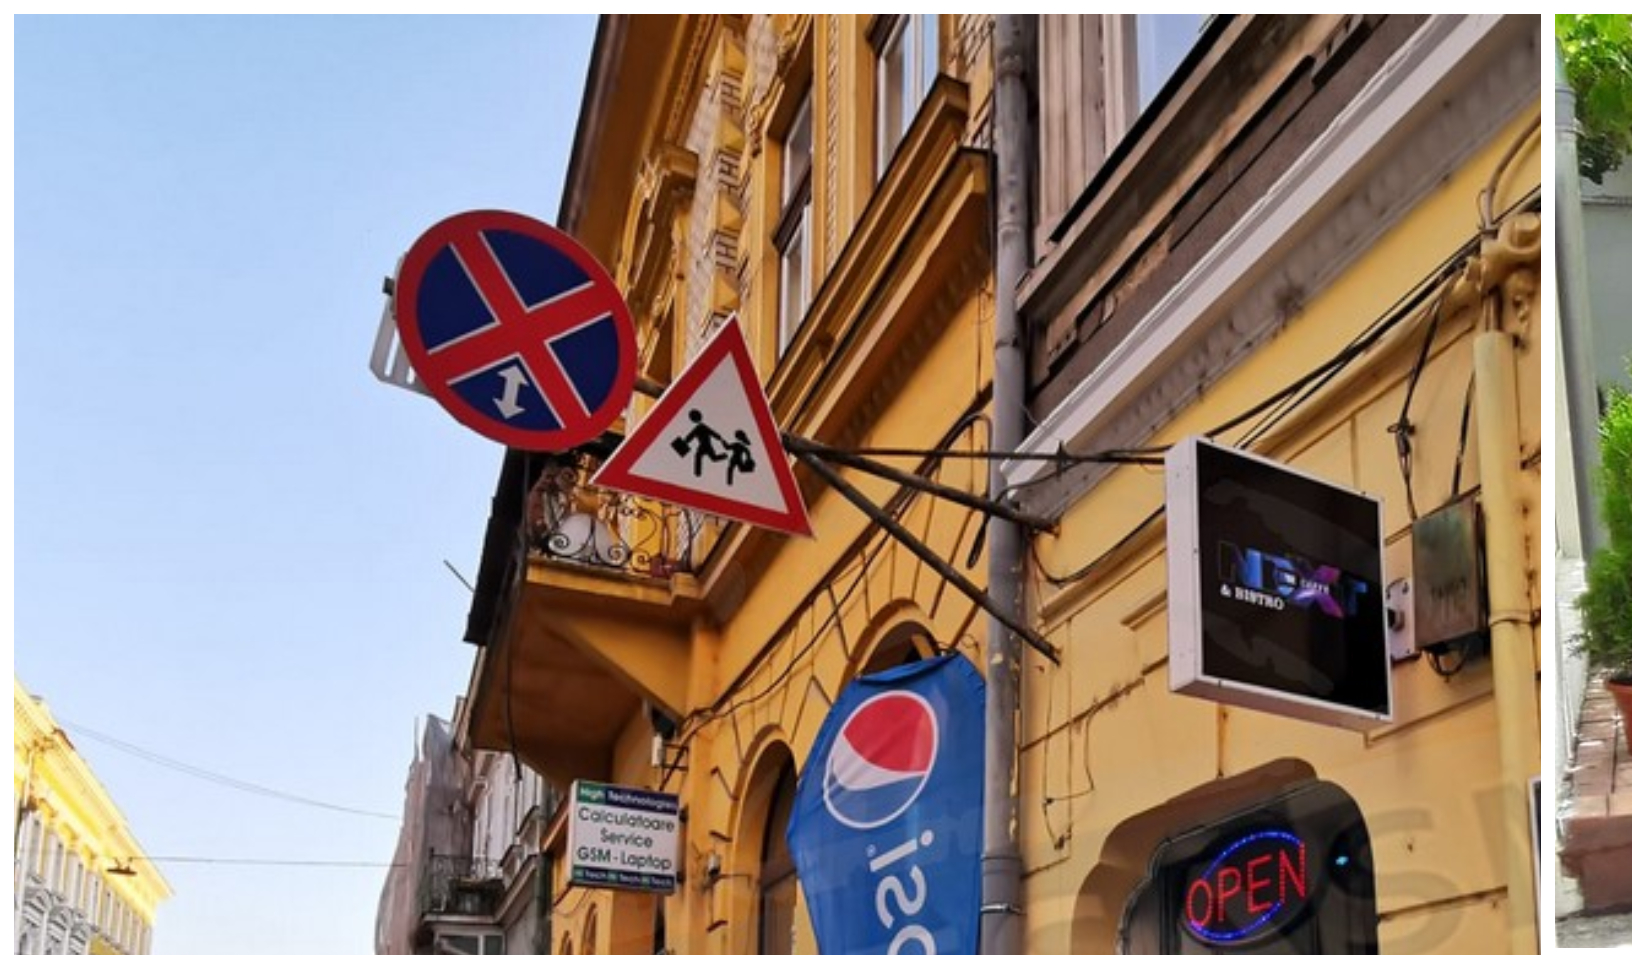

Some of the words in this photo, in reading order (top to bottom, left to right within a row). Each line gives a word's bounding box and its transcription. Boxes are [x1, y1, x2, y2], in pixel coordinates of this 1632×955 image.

[1220, 583, 1232, 598] &
[1234, 586, 1285, 611] BISTRO
[578, 806, 675, 832] Calculatoare
[600, 826, 653, 849] Service
[577, 845, 611, 863] GSM
[620, 850, 672, 870] Laptop
[1186, 842, 1306, 928] OPEN
